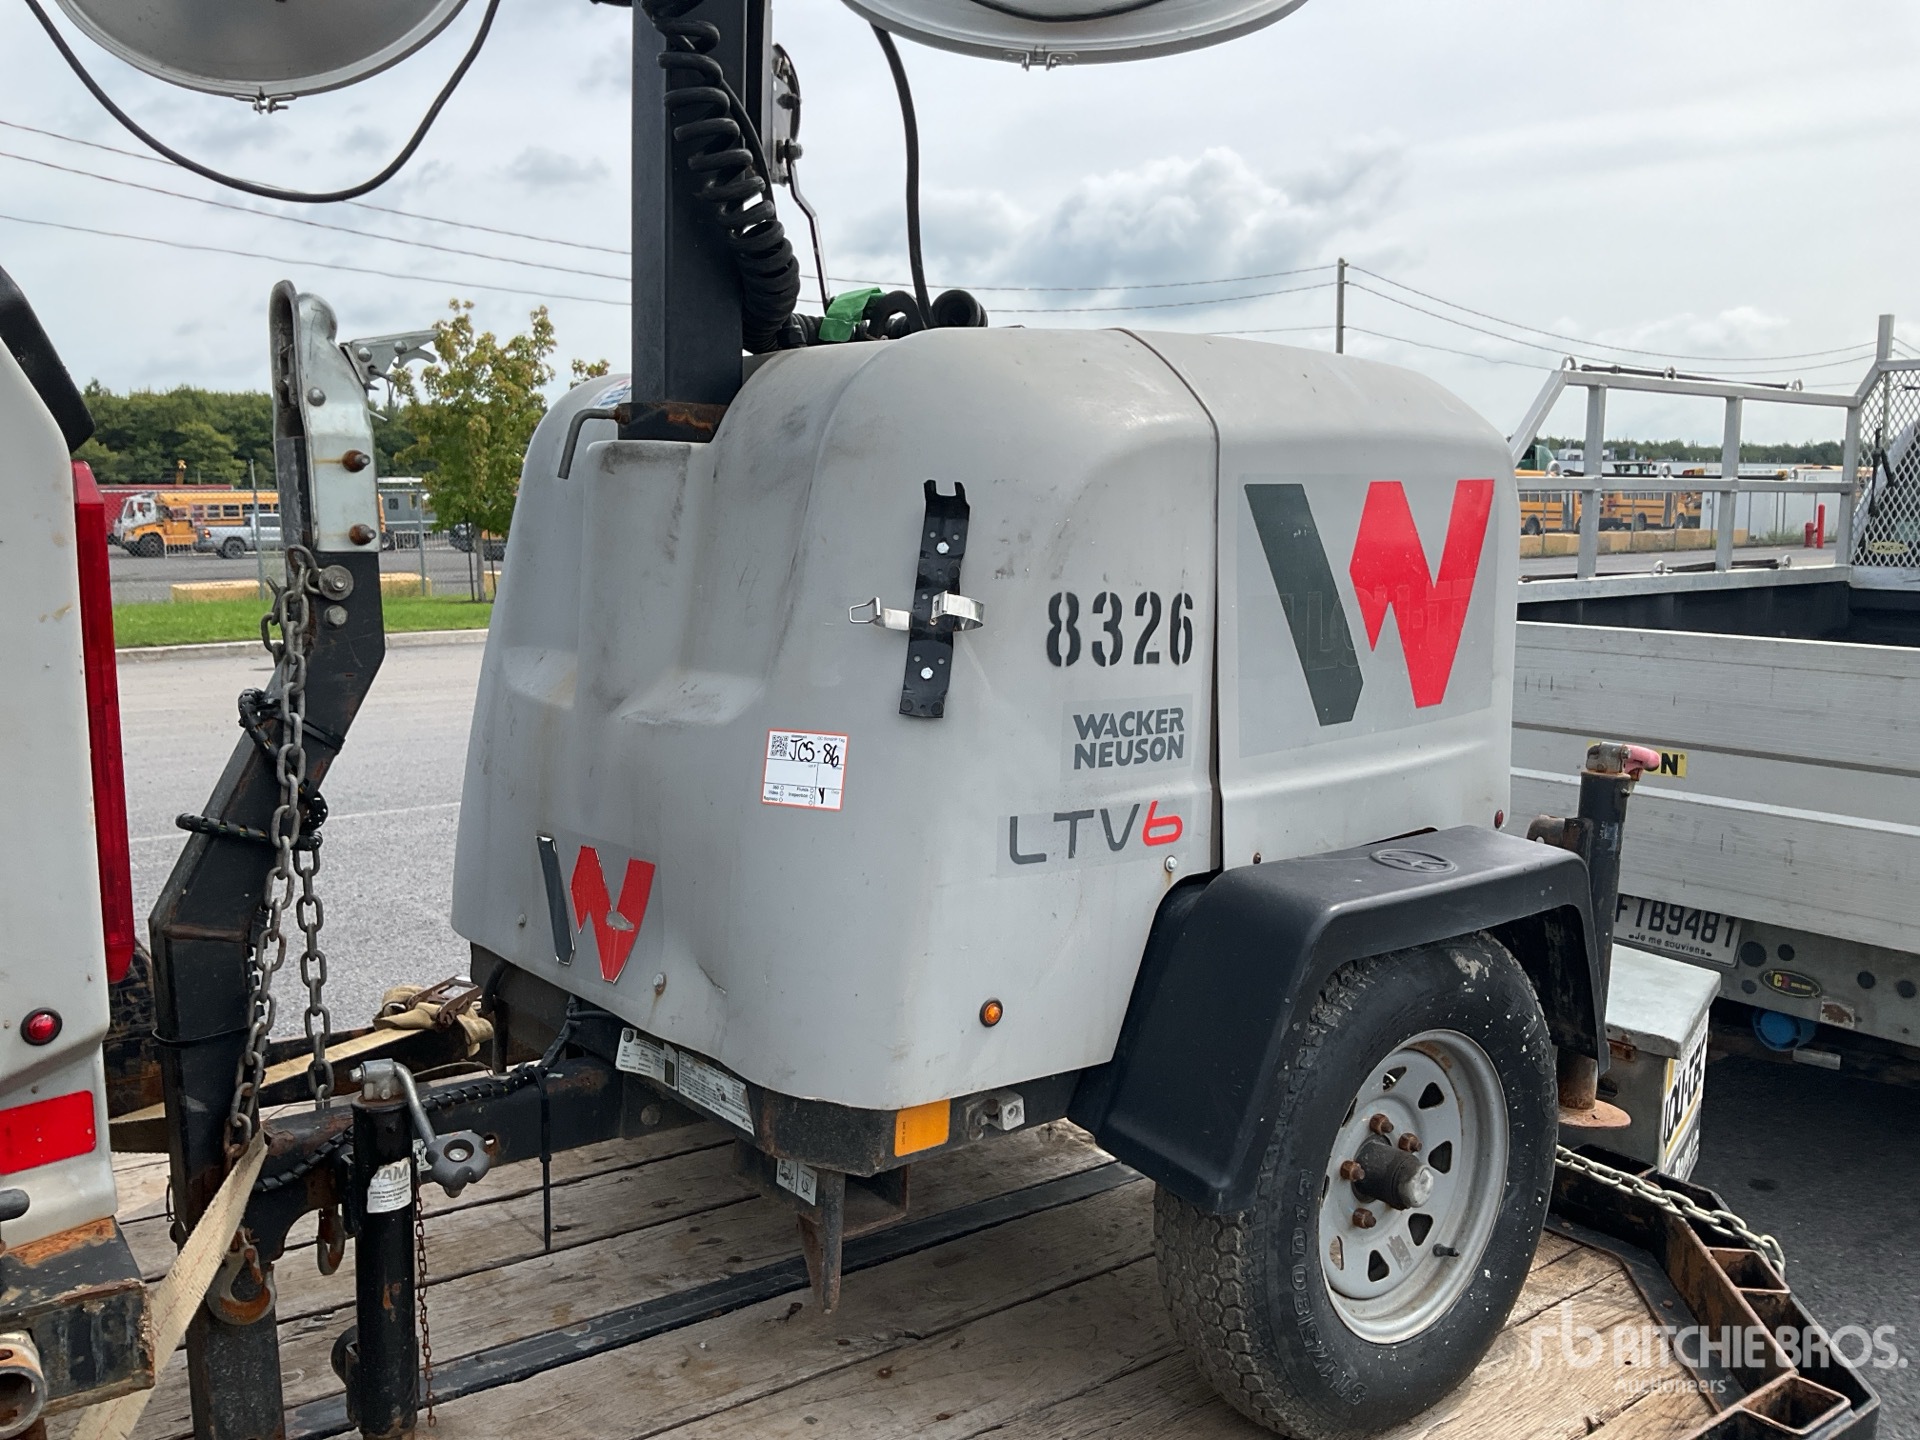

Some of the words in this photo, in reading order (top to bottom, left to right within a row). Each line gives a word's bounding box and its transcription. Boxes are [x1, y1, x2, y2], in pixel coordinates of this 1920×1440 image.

[1046, 591, 1193, 667] 8326
[1073, 707, 1184, 740] WACKER
[1073, 734, 1184, 770] NEUSON
[1009, 800, 1184, 865] LTV6
[1634, 932, 1646, 941] Je
[1648, 936, 1662, 946] me
[1664, 940, 1706, 956] souviens
